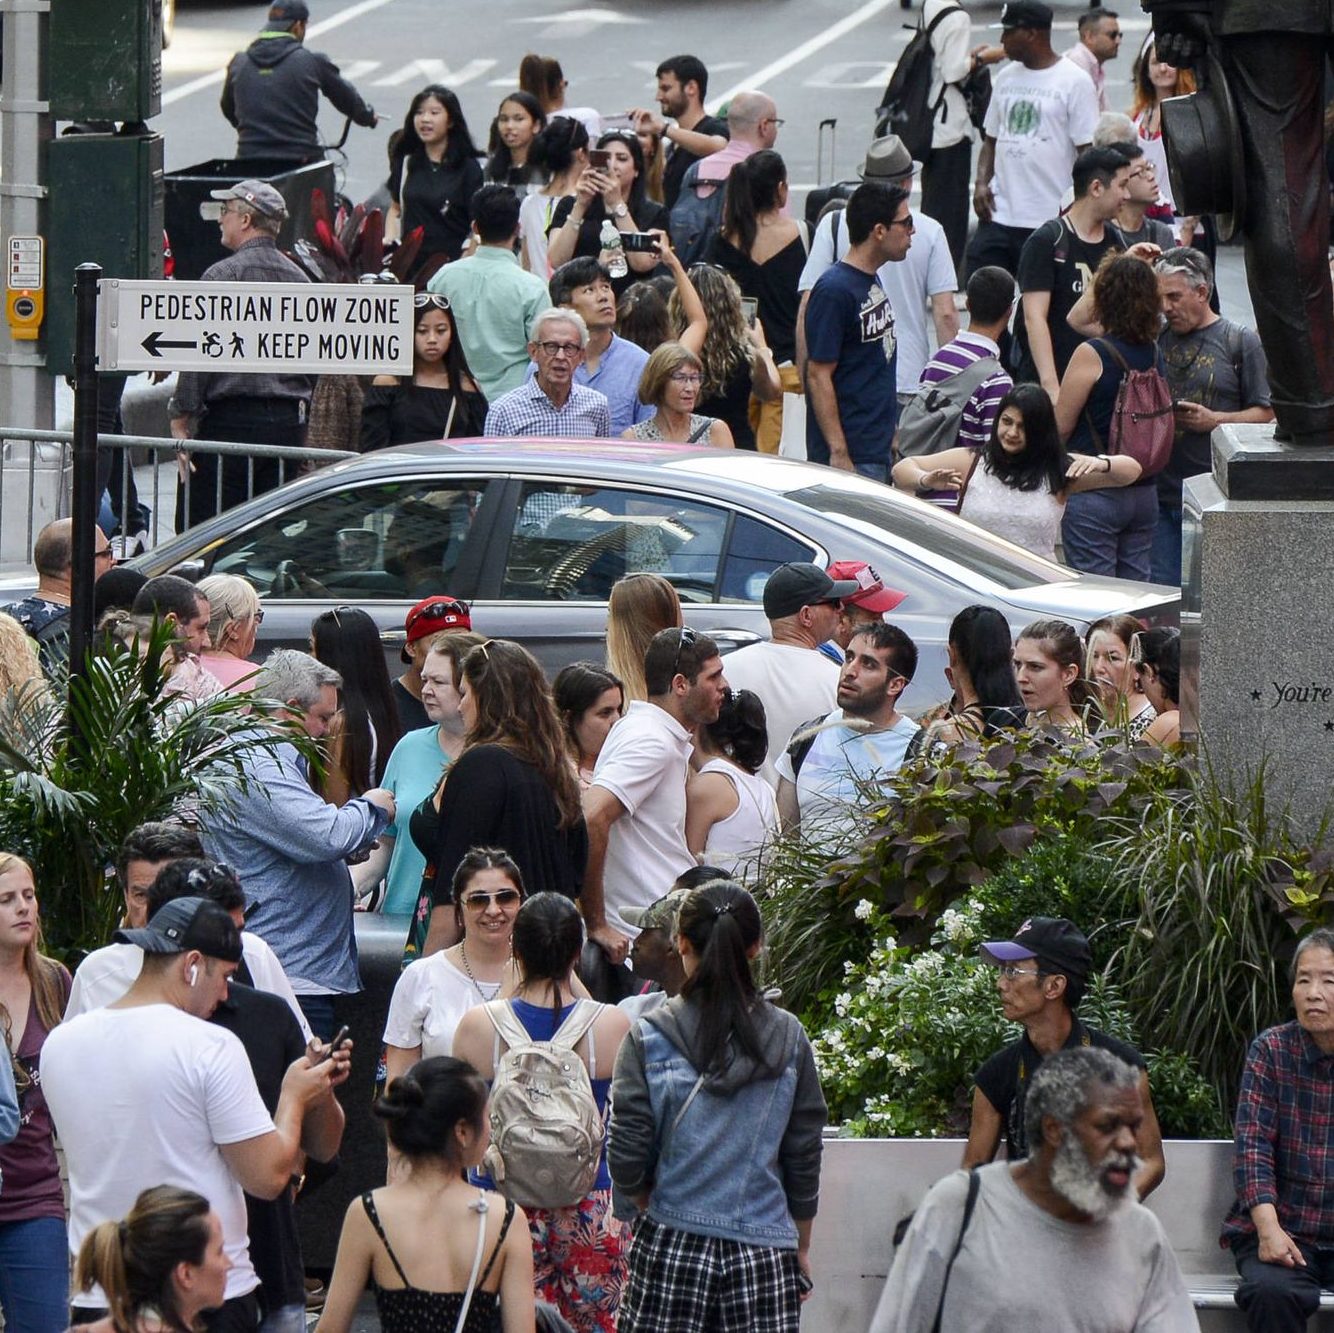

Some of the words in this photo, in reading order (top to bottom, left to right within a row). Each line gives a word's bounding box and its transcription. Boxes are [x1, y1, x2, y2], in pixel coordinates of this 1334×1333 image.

[138, 292, 273, 321] PEDESTRIAN
[278, 295, 340, 323] FLOW
[343, 296, 400, 324] ZONE
[256, 332, 312, 360] KEEP
[318, 334, 401, 362] MOVING
[1271, 680, 1333, 712] You're
